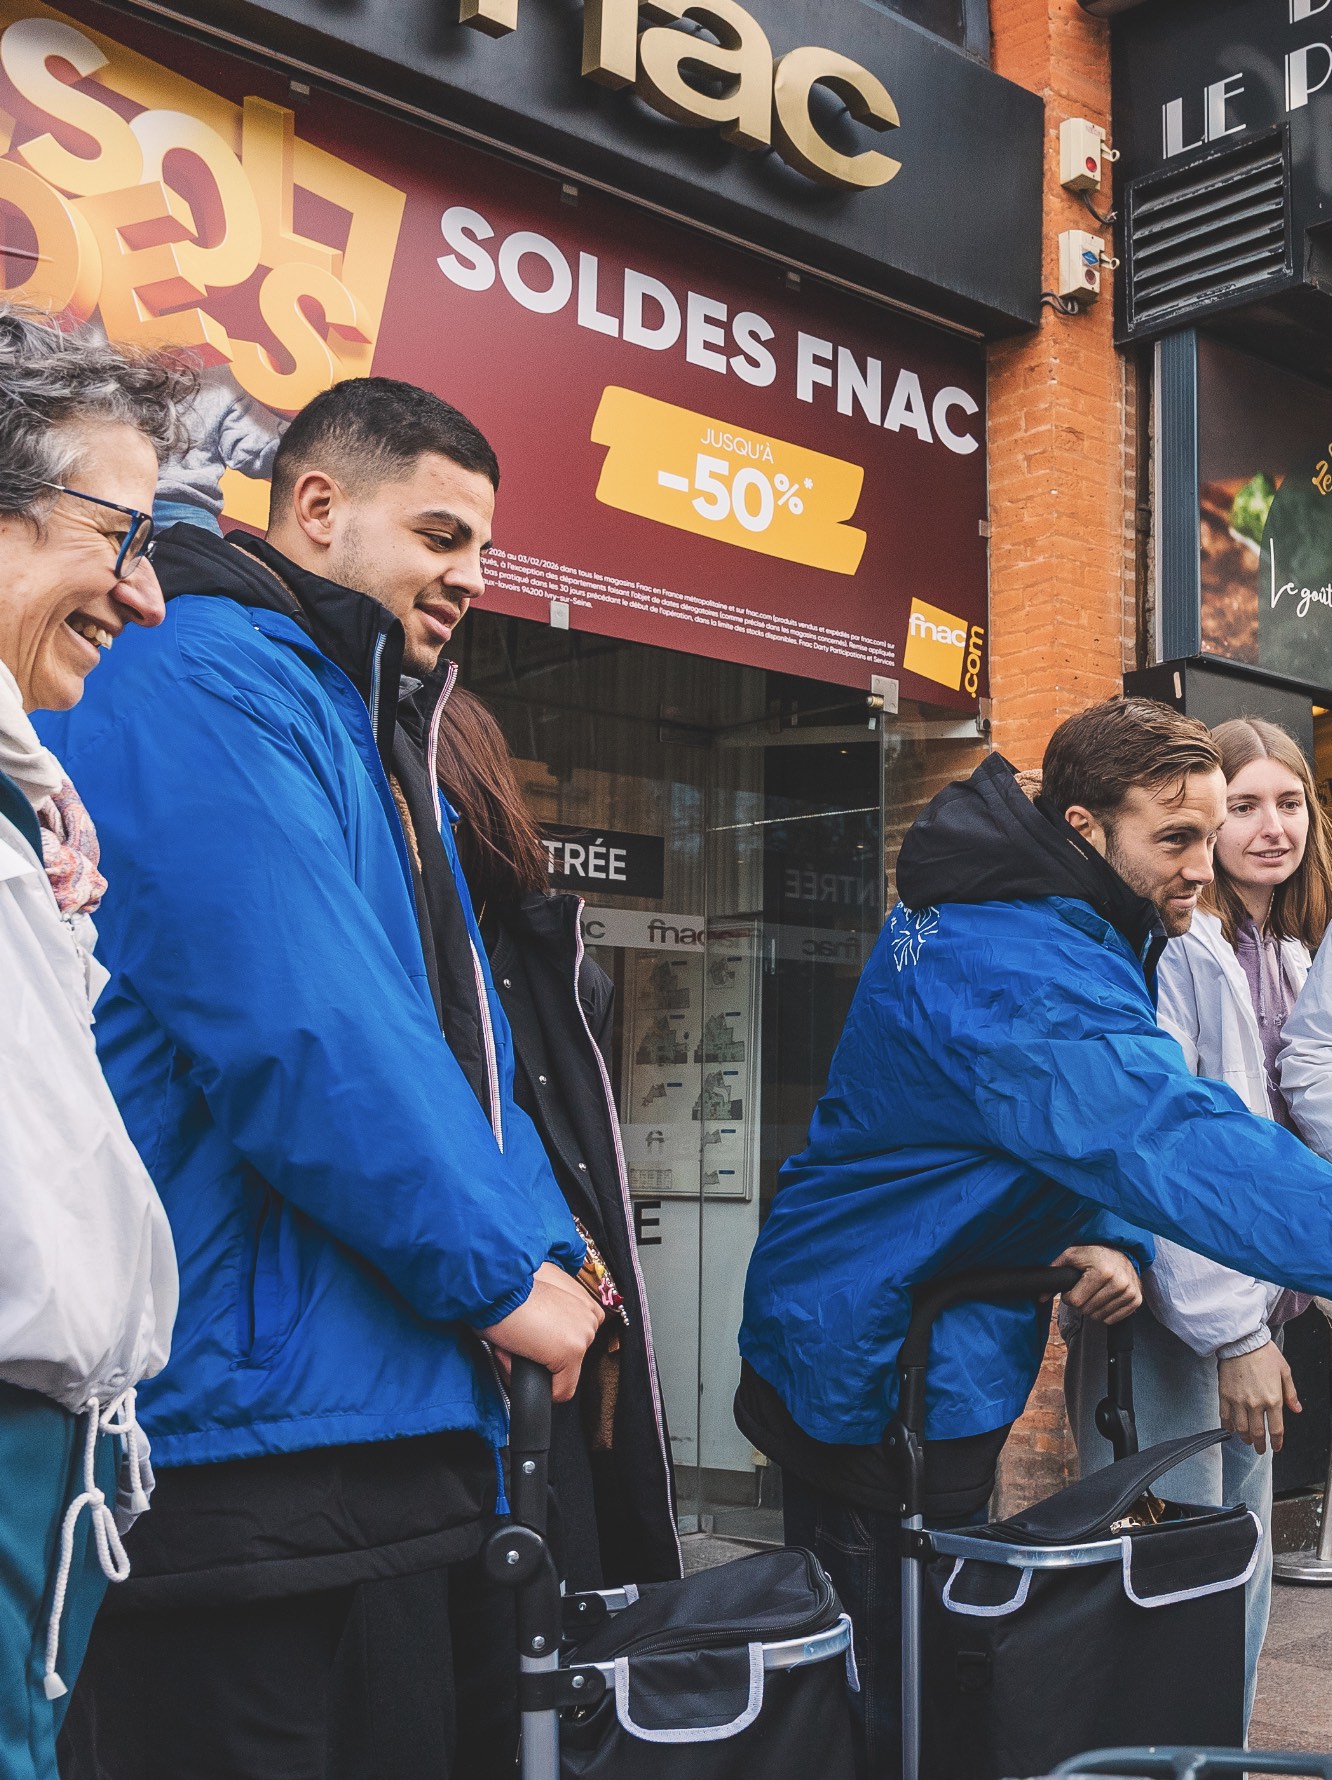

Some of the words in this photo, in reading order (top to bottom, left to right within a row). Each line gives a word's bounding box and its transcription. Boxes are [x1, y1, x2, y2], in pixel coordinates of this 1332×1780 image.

[1162, 72, 1247, 160] LE
[436, 206, 778, 388] SOLDES
[796, 330, 980, 455] FNAC
[701, 428, 774, 464] JUSQU'À
[500, 559, 506, 568] à
[507, 561, 544, 577] l'exception
[546, 570, 558, 580] des
[560, 573, 606, 591] départements
[608, 585, 630, 597] faisant
[631, 590, 650, 602] l'objet
[652, 595, 660, 604] de
[661, 597, 679, 608] dates
[680, 601, 718, 617] dérogatoires
[744, 618, 765, 628] précisé
[766, 621, 780, 632] dans
[781, 625, 789, 634] les
[790, 628, 816, 640] magasins
[849, 641, 868, 652] Remise
[869, 647, 895, 659] appliquée
[507, 553, 516, 561] au
[518, 554, 559, 571] 03/02/2026
[560, 564, 577, 575] dans
[579, 568, 592, 579] tous
[594, 572, 603, 581] les
[604, 576, 635, 589] magasins
[636, 582, 652, 593] Fnac
[653, 587, 661, 595] en
[662, 588, 683, 600] France
[684, 594, 727, 610] métropolitaine
[729, 604, 735, 612] et
[746, 608, 772, 621] fnac.com
[798, 621, 818, 632] vendus
[819, 625, 825, 633] et
[826, 628, 850, 639] expédiés
[851, 634, 860, 642] par
[887, 642, 895, 650] sur
[521, 584, 543, 596] 94200
[544, 589, 593, 607] Ivry-sur-Seine.
[1269, 537, 1298, 609] Le
[484, 565, 498, 575] bas
[499, 570, 529, 583] pratiqué
[530, 576, 548, 587] dans
[549, 580, 558, 589] les
[560, 583, 568, 592] 30
[570, 585, 586, 596] jours
[587, 590, 620, 604] précédant
[622, 597, 628, 606] le
[629, 599, 648, 610] début
[650, 604, 658, 613] de
[660, 606, 693, 622] l'opération,
[694, 614, 710, 625] dans
[711, 618, 716, 626] la
[718, 619, 733, 630] limite
[734, 623, 745, 633] des
[746, 627, 764, 637] stocks
[765, 630, 798, 645] disponibles.
[799, 638, 812, 648] Fnac
[814, 642, 829, 654] Darty
[830, 645, 866, 661] Participations
[874, 656, 895, 667] Services
[909, 613, 967, 648] fnac
[964, 625, 985, 699] .com
